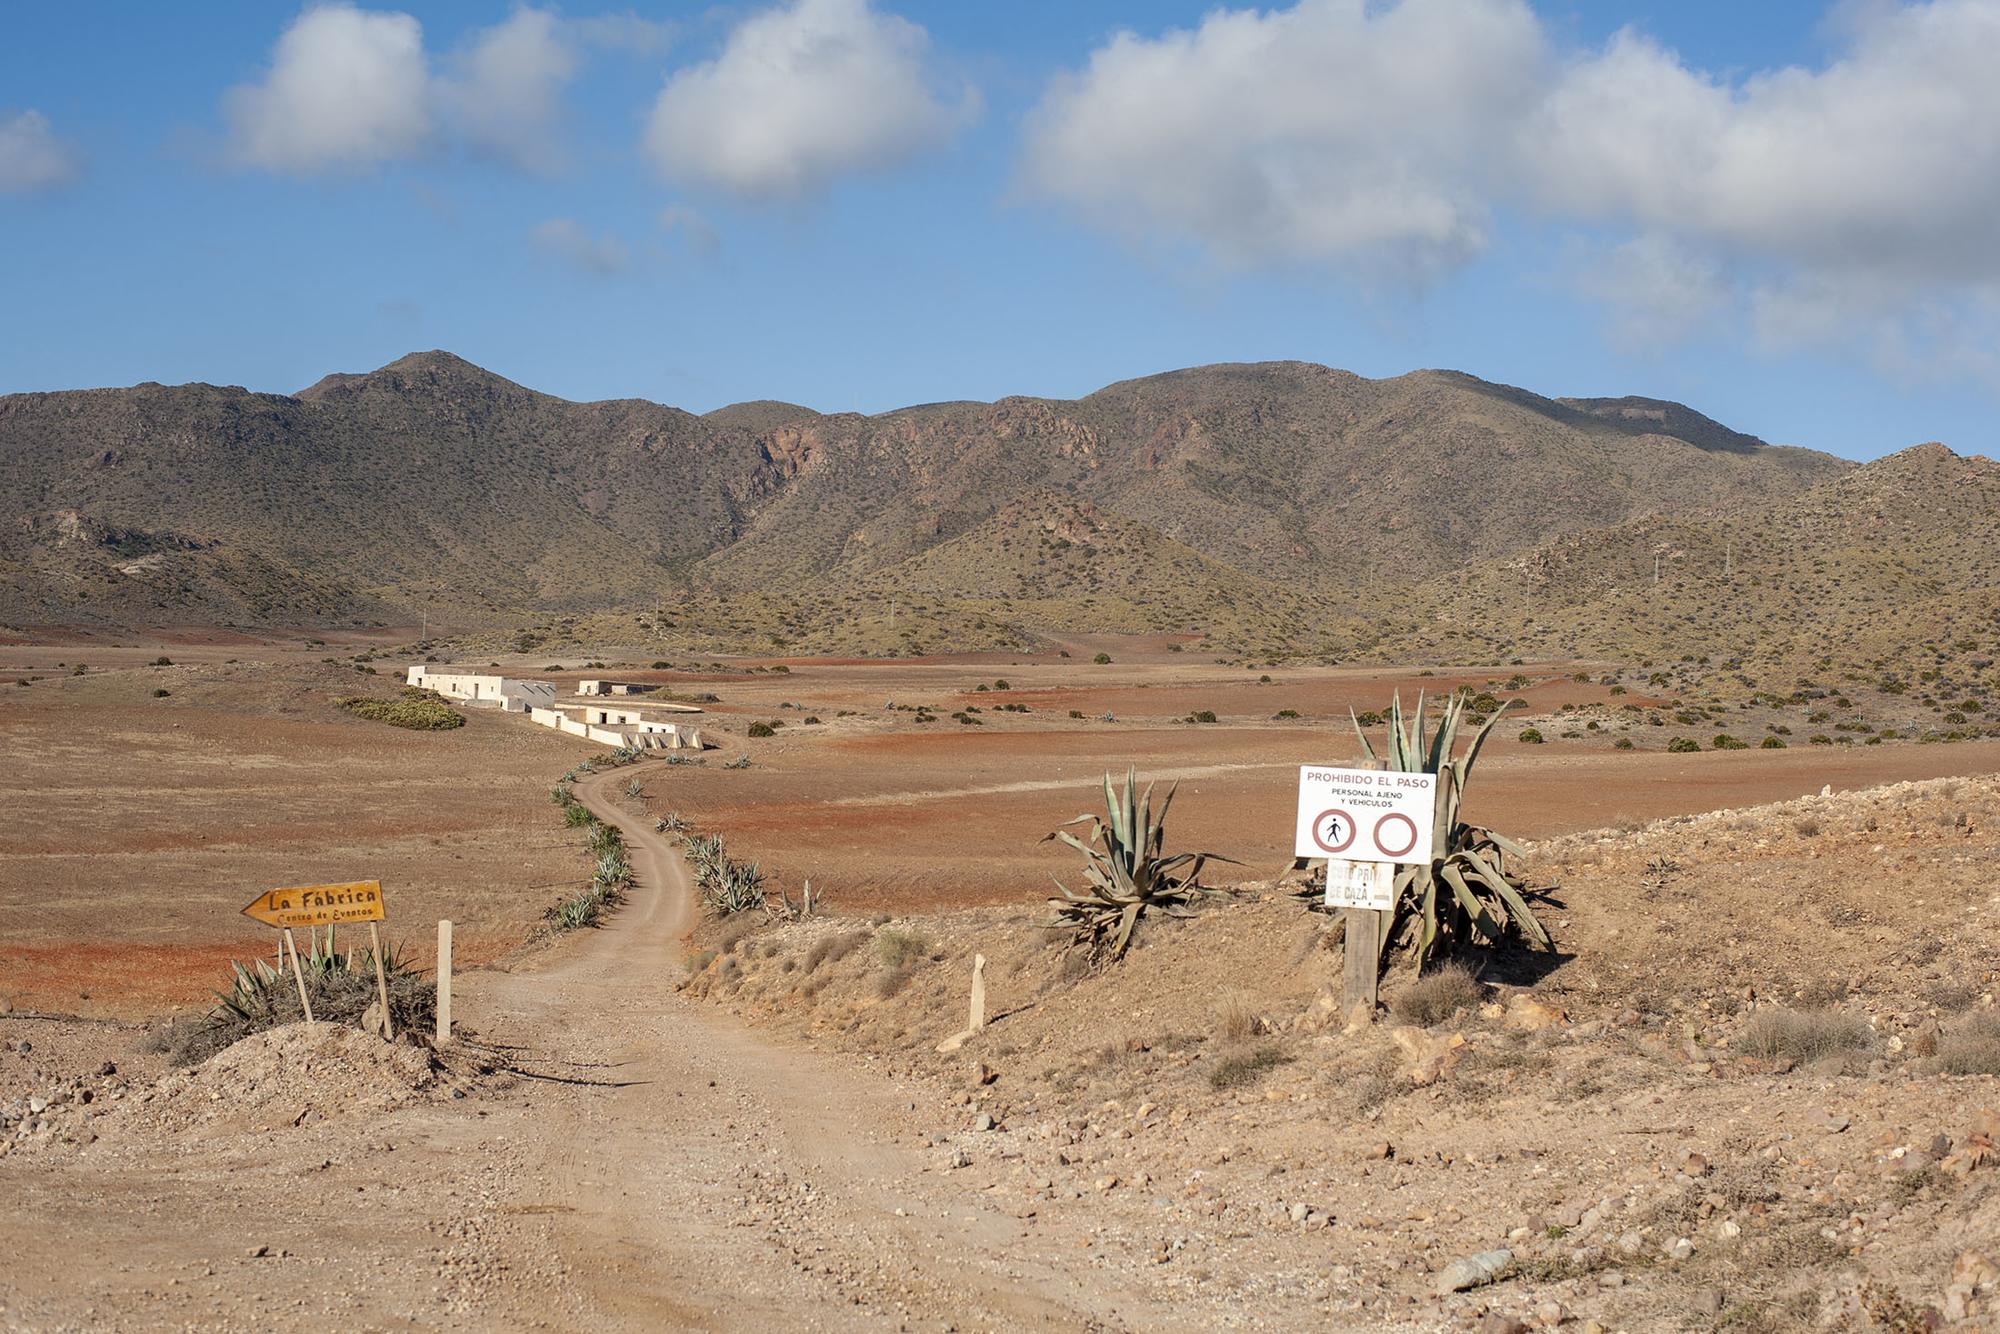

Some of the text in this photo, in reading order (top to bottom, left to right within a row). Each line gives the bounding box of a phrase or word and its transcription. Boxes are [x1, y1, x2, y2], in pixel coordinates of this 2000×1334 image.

[1307, 772, 1429, 788] PROHIBIDO EL PASO
[1332, 788, 1373, 797] PERSONAL
[1349, 799, 1393, 808] VEHICULOS
[269, 888, 376, 911] La Fábrica
[1344, 886, 1367, 900] CAZA
[277, 908, 373, 924] Centro de Eventos
